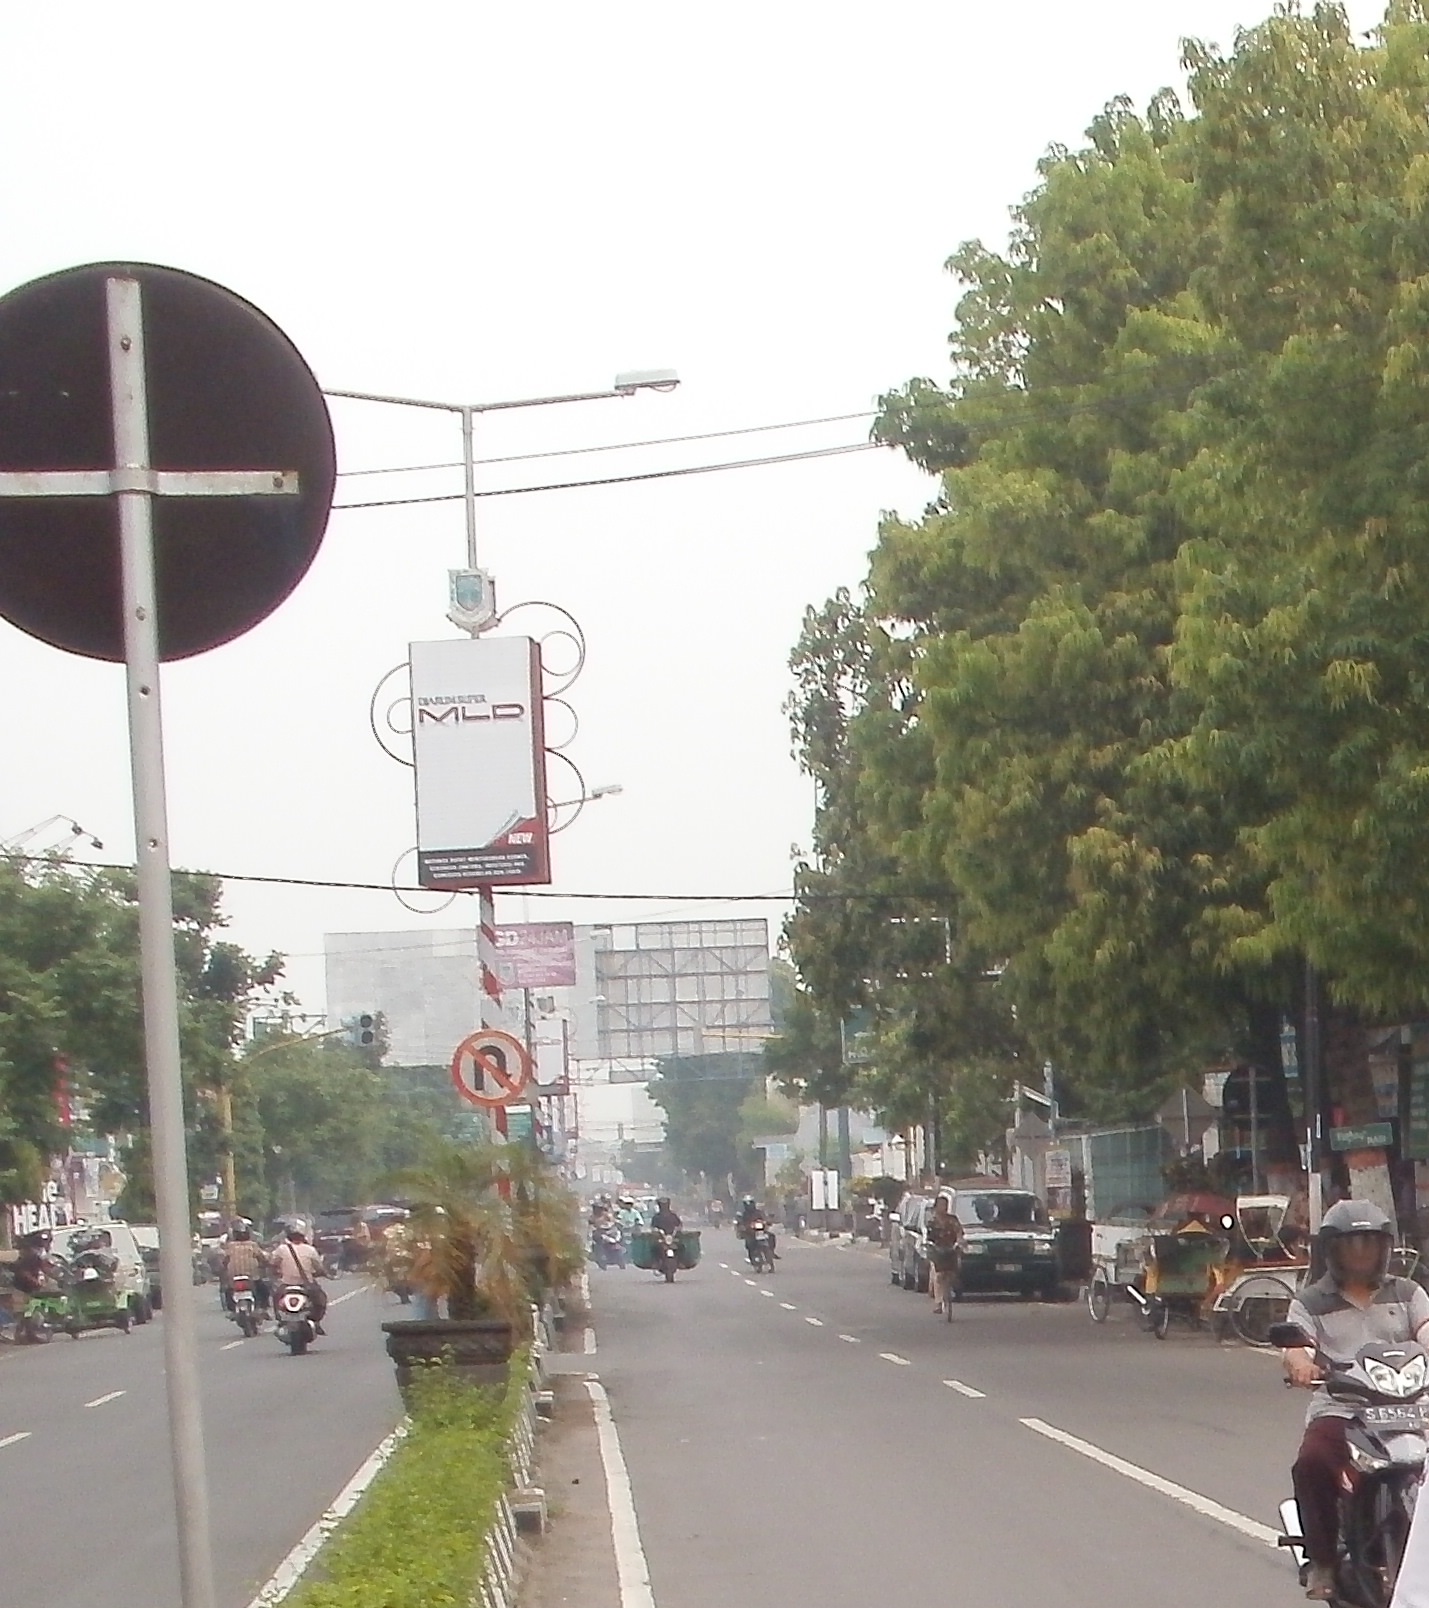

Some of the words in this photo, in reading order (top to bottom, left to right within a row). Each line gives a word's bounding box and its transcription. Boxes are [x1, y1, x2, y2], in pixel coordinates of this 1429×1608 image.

[418, 703, 525, 723] MLD
[508, 832, 533, 845] NEW
[1365, 1407, 1376, 1420] S
